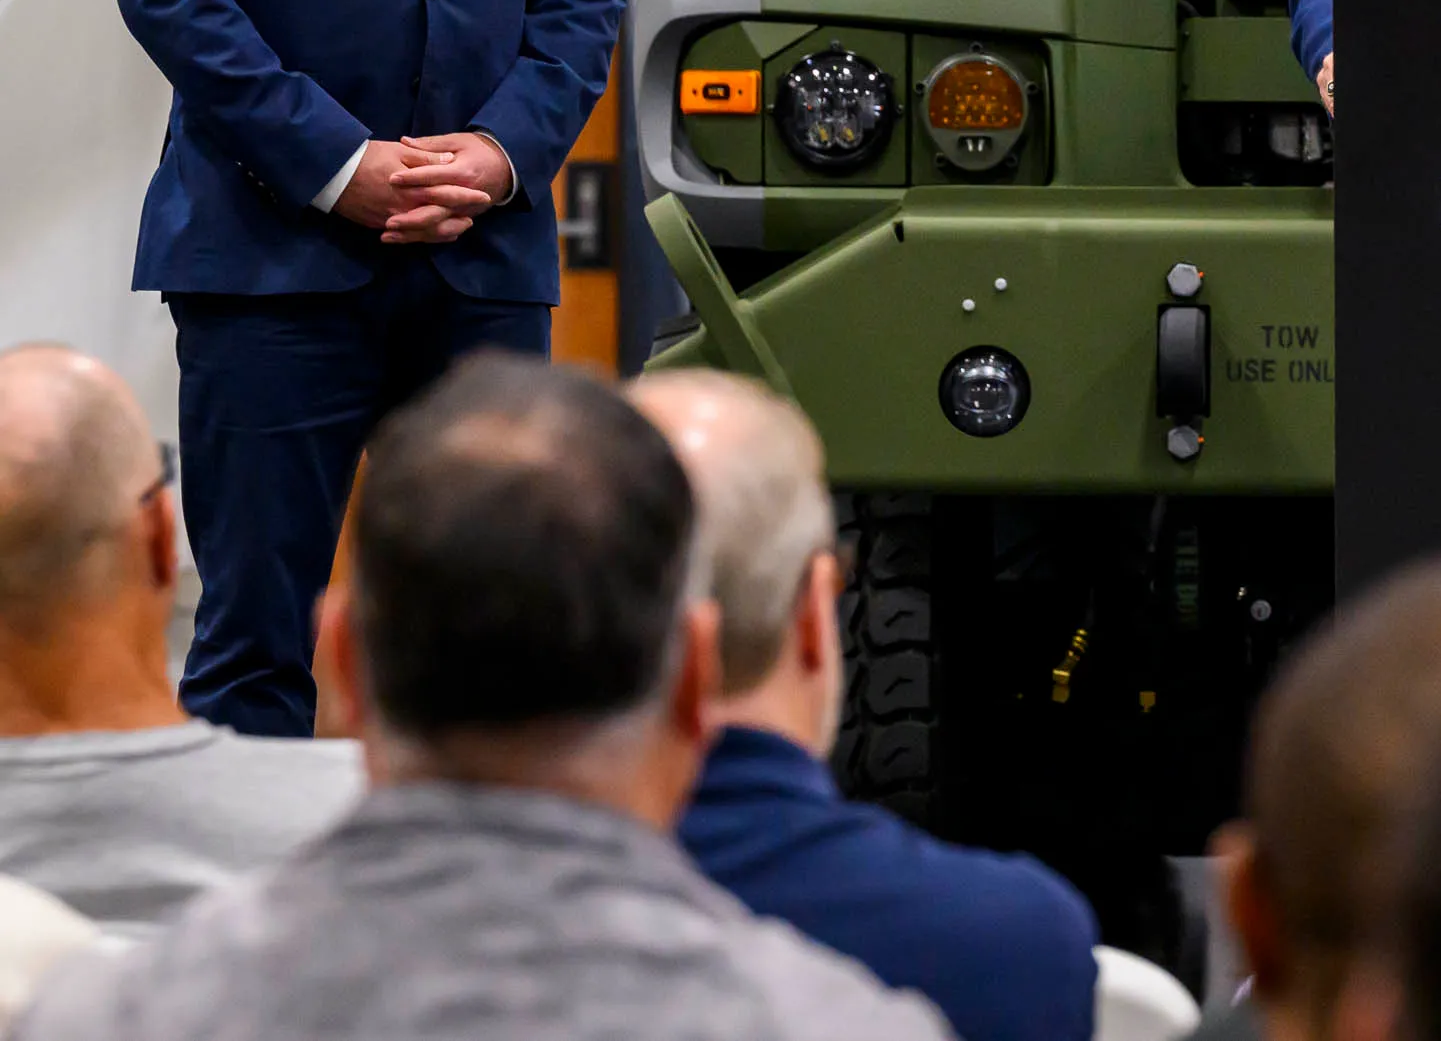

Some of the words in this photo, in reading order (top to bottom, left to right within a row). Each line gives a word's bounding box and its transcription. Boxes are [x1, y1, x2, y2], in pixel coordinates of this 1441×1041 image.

[1261, 325, 1319, 349] TOW
[1226, 359, 1277, 383] USE
[1288, 359, 1335, 383] ONL
